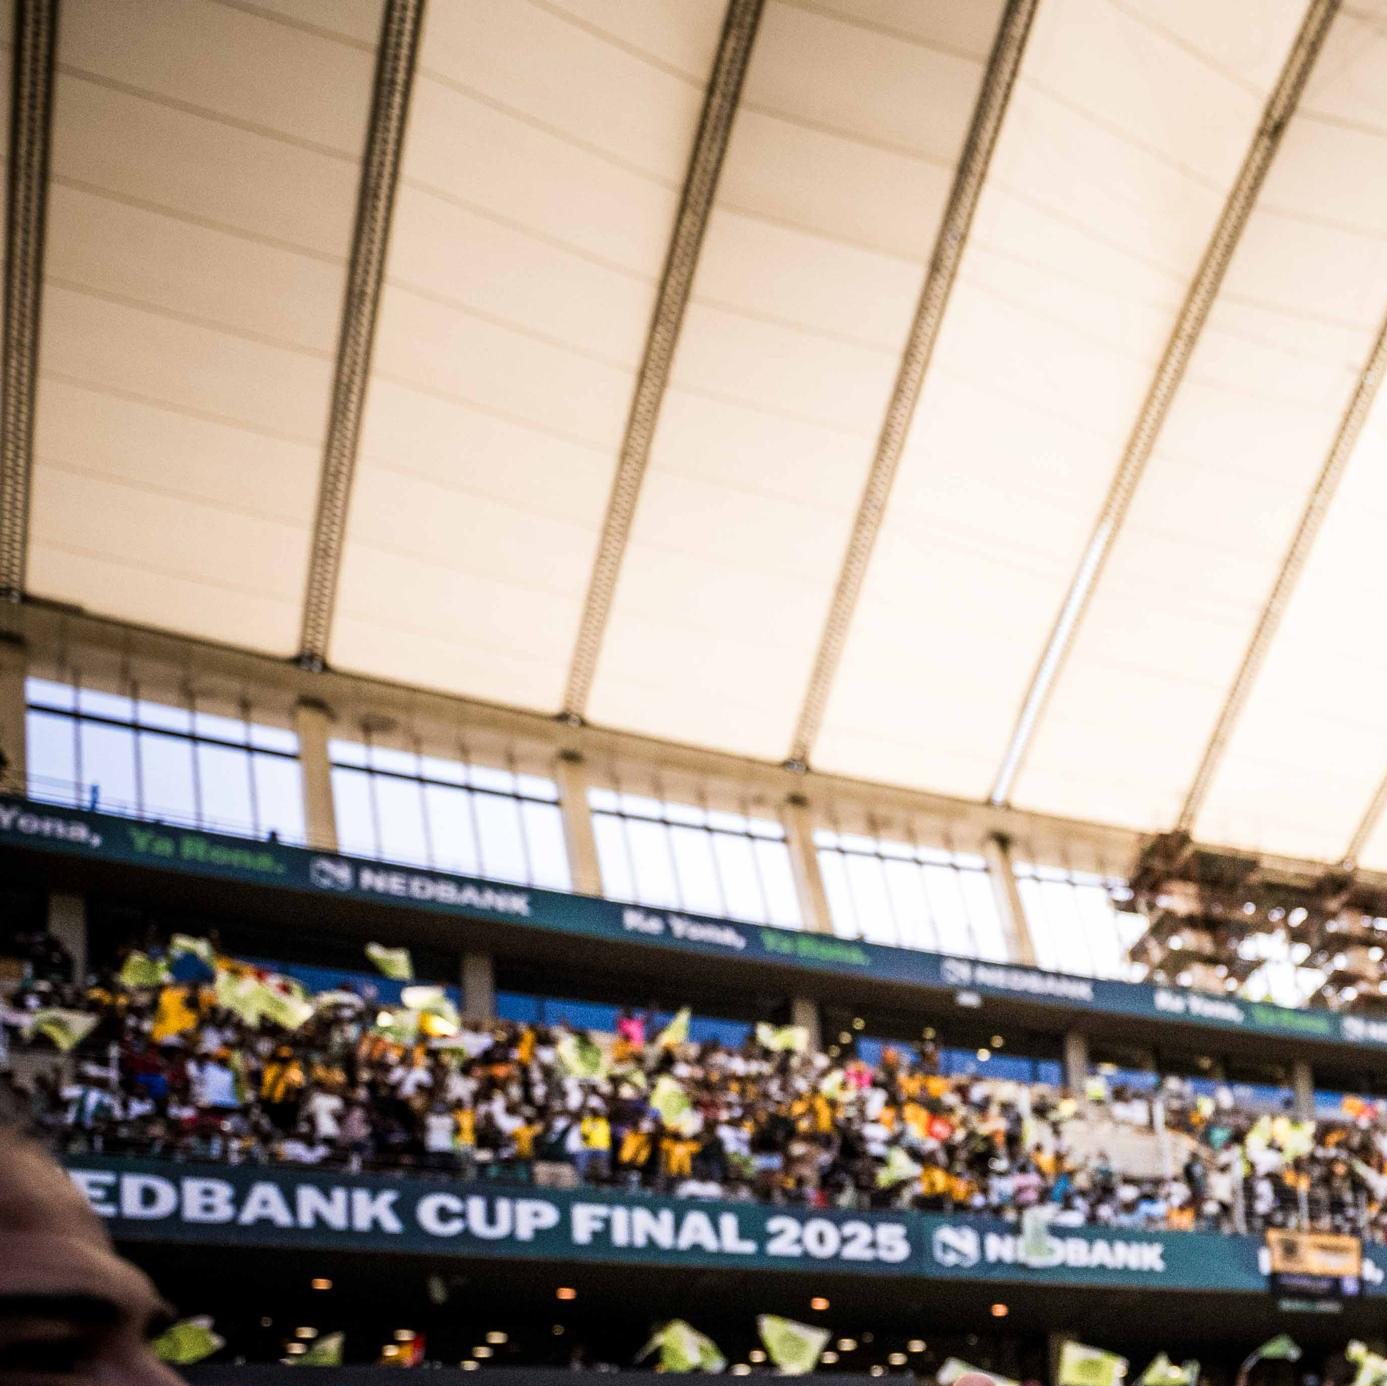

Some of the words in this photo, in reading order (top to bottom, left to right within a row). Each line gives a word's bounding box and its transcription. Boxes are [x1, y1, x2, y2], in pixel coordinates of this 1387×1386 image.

[359, 866, 530, 917] NEDBANK
[68, 1168, 402, 1234] EDBANK
[415, 1192, 559, 1241] CUP
[571, 1203, 757, 1255] FINAL
[765, 1216, 911, 1263] 2025
[983, 1232, 1166, 1272] NDBANK
